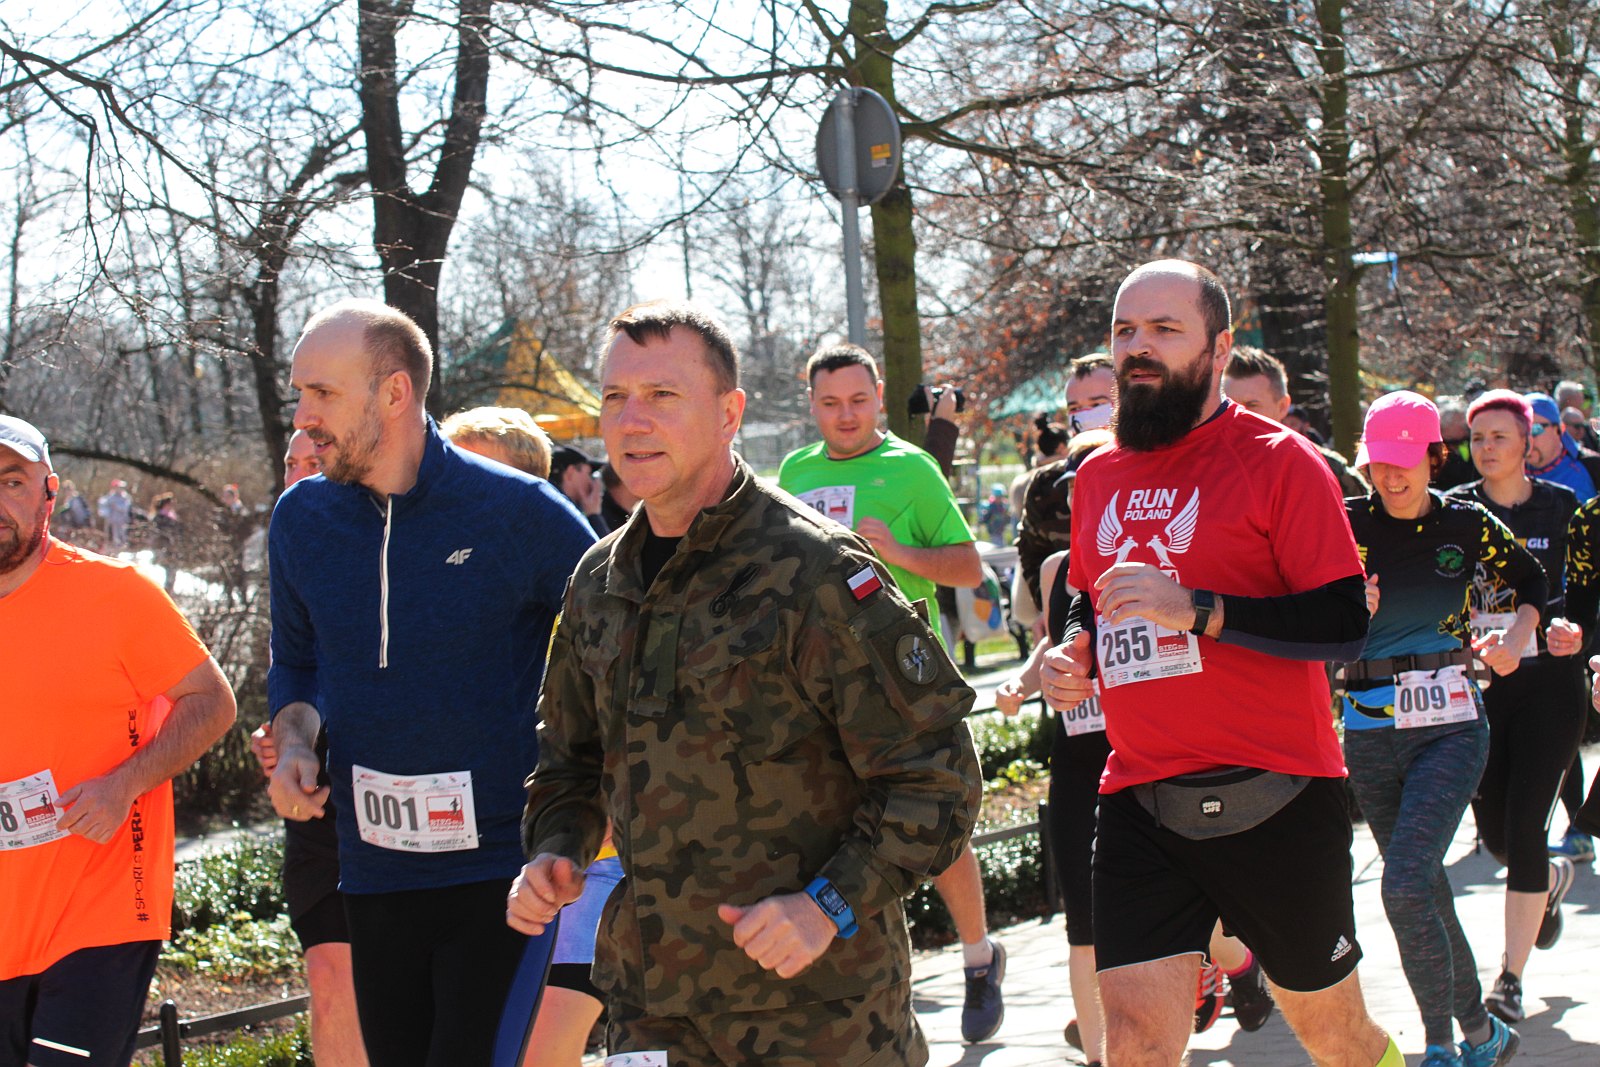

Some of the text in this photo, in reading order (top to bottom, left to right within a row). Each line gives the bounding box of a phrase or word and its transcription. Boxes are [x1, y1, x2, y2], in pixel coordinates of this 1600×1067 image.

[1127, 488, 1178, 510] RUN
[1123, 509, 1172, 521] POLAND
[1527, 538, 1549, 549] GLS
[445, 548, 473, 565] 4F
[1102, 625, 1151, 668] 255
[1400, 685, 1447, 713] 009
[364, 790, 419, 832] 001
[1331, 943, 1352, 962] adidas
